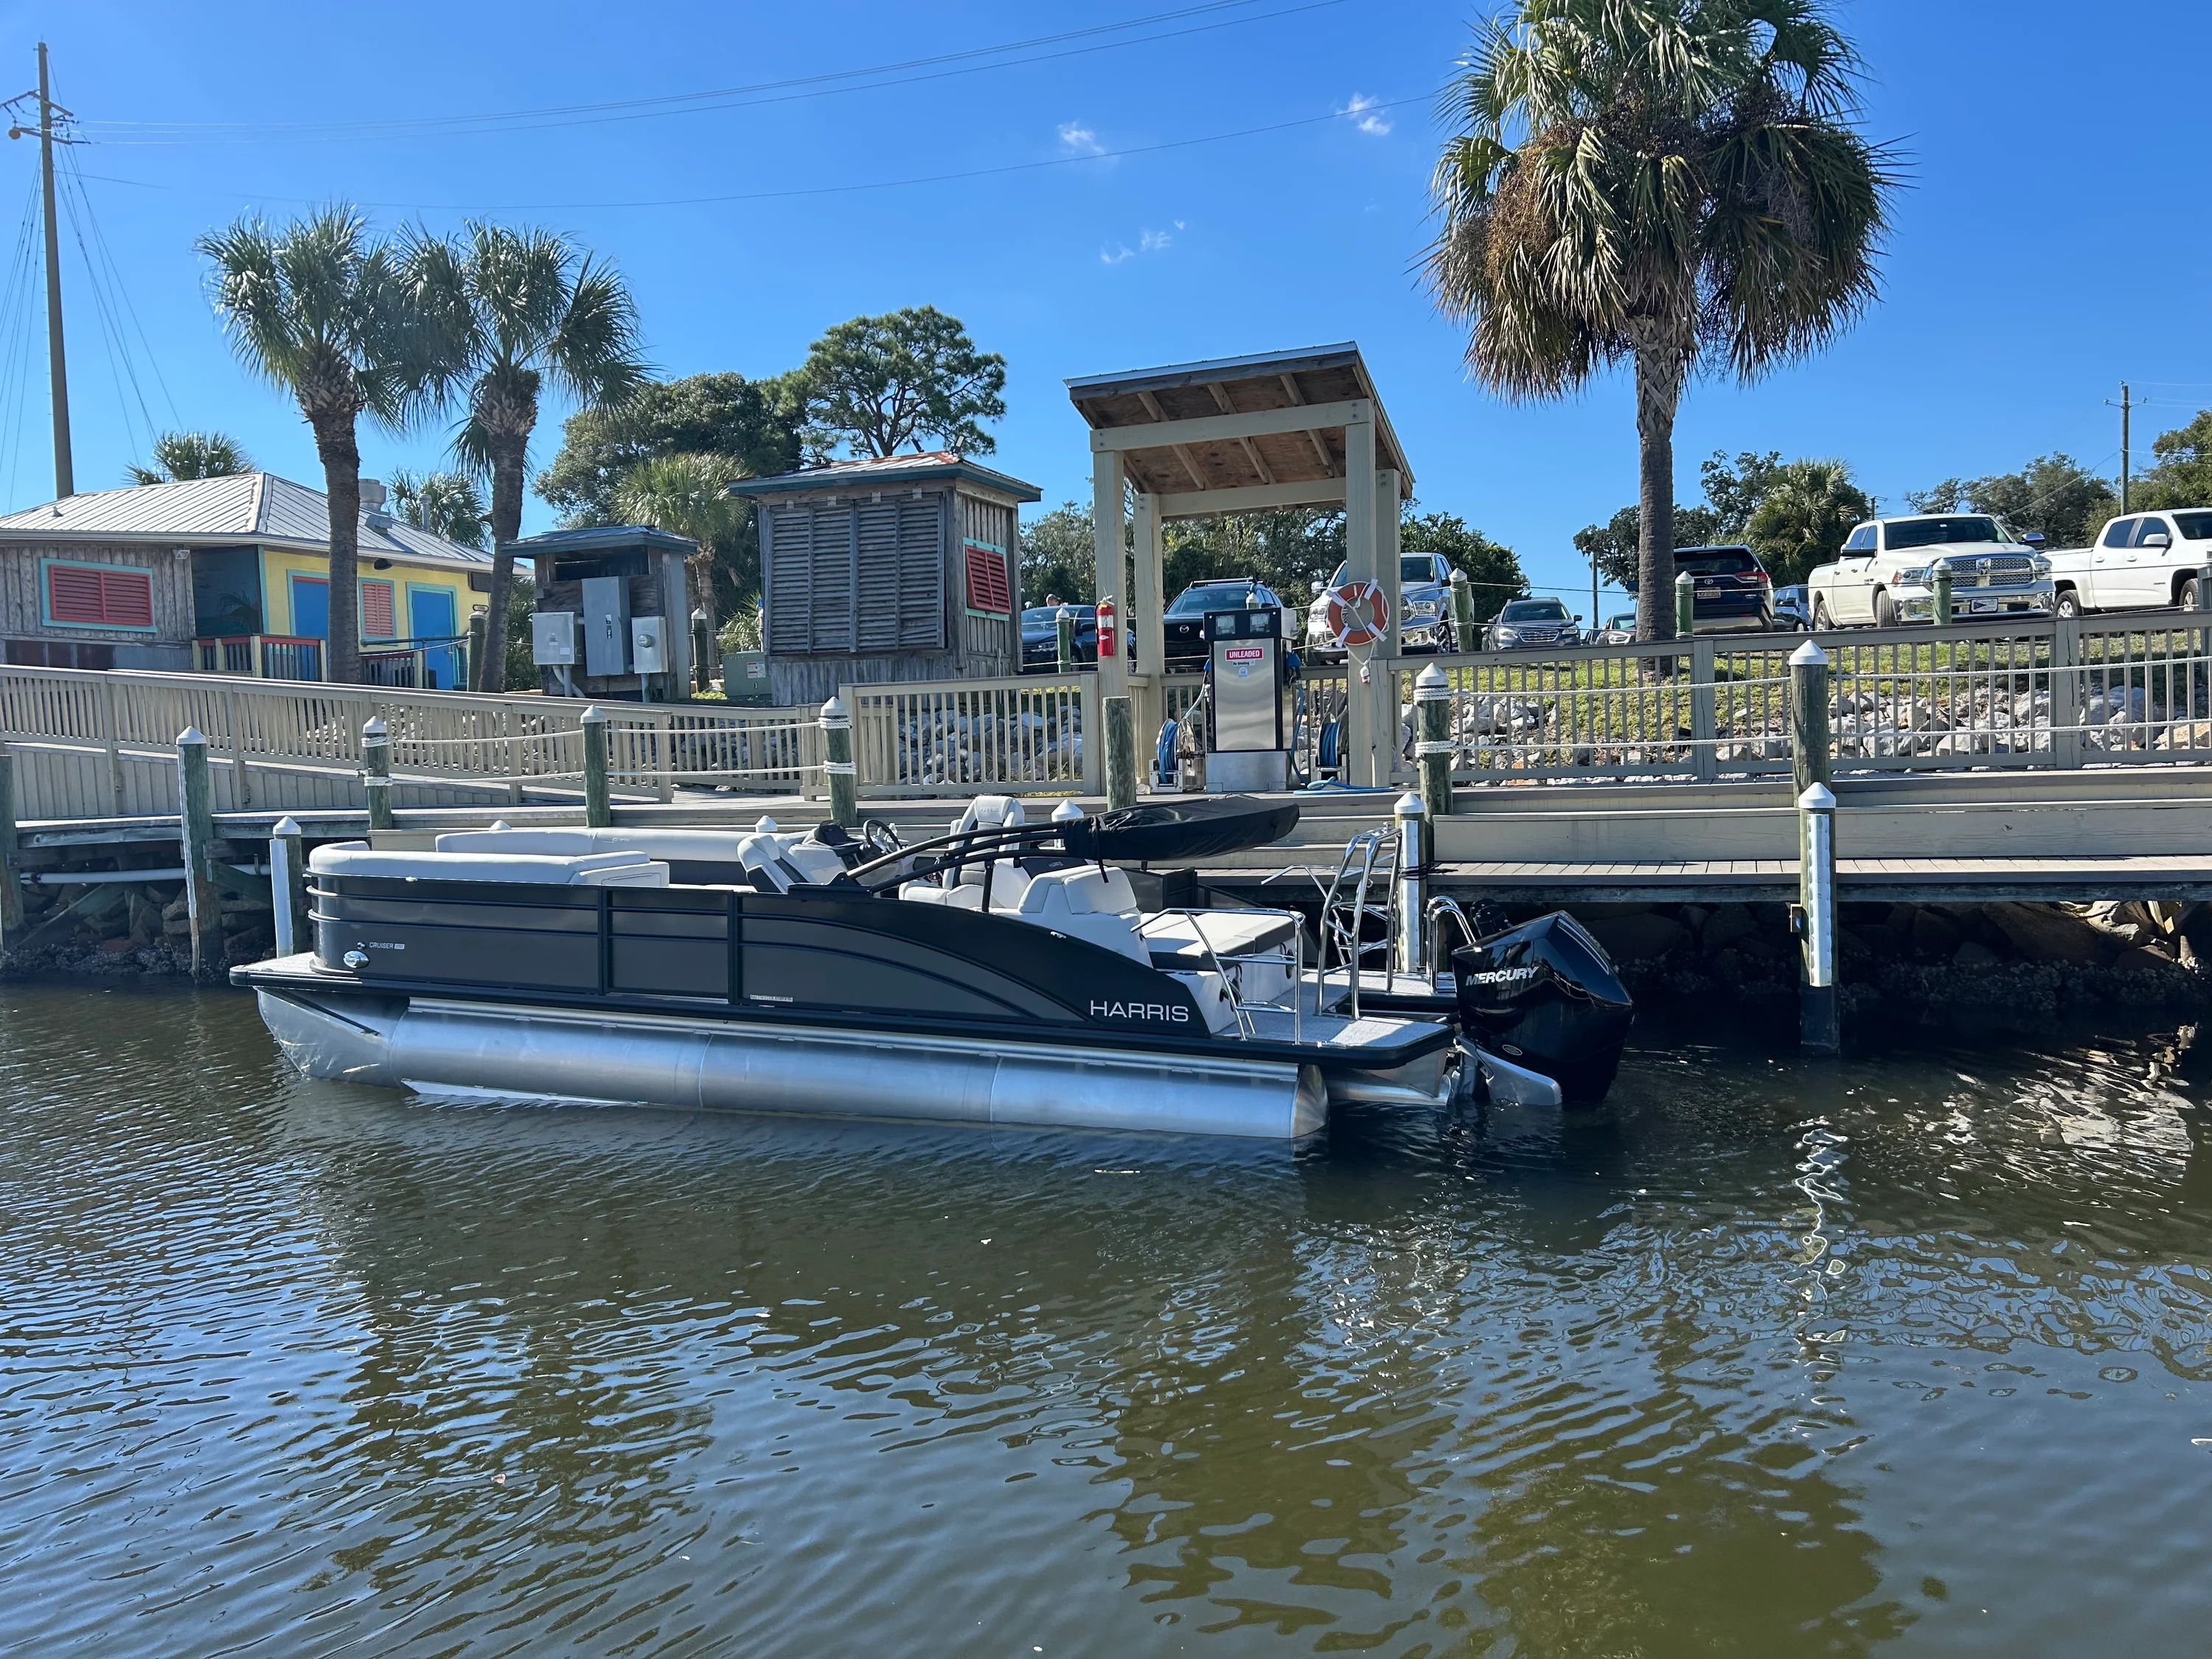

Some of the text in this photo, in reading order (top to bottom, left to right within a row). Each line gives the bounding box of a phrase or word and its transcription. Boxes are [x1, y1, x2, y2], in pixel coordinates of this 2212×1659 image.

[1229, 650, 1260, 658] UNLEADED
[1465, 966, 1540, 987] MERCURY
[1090, 1000, 1189, 1022] HARRIS
